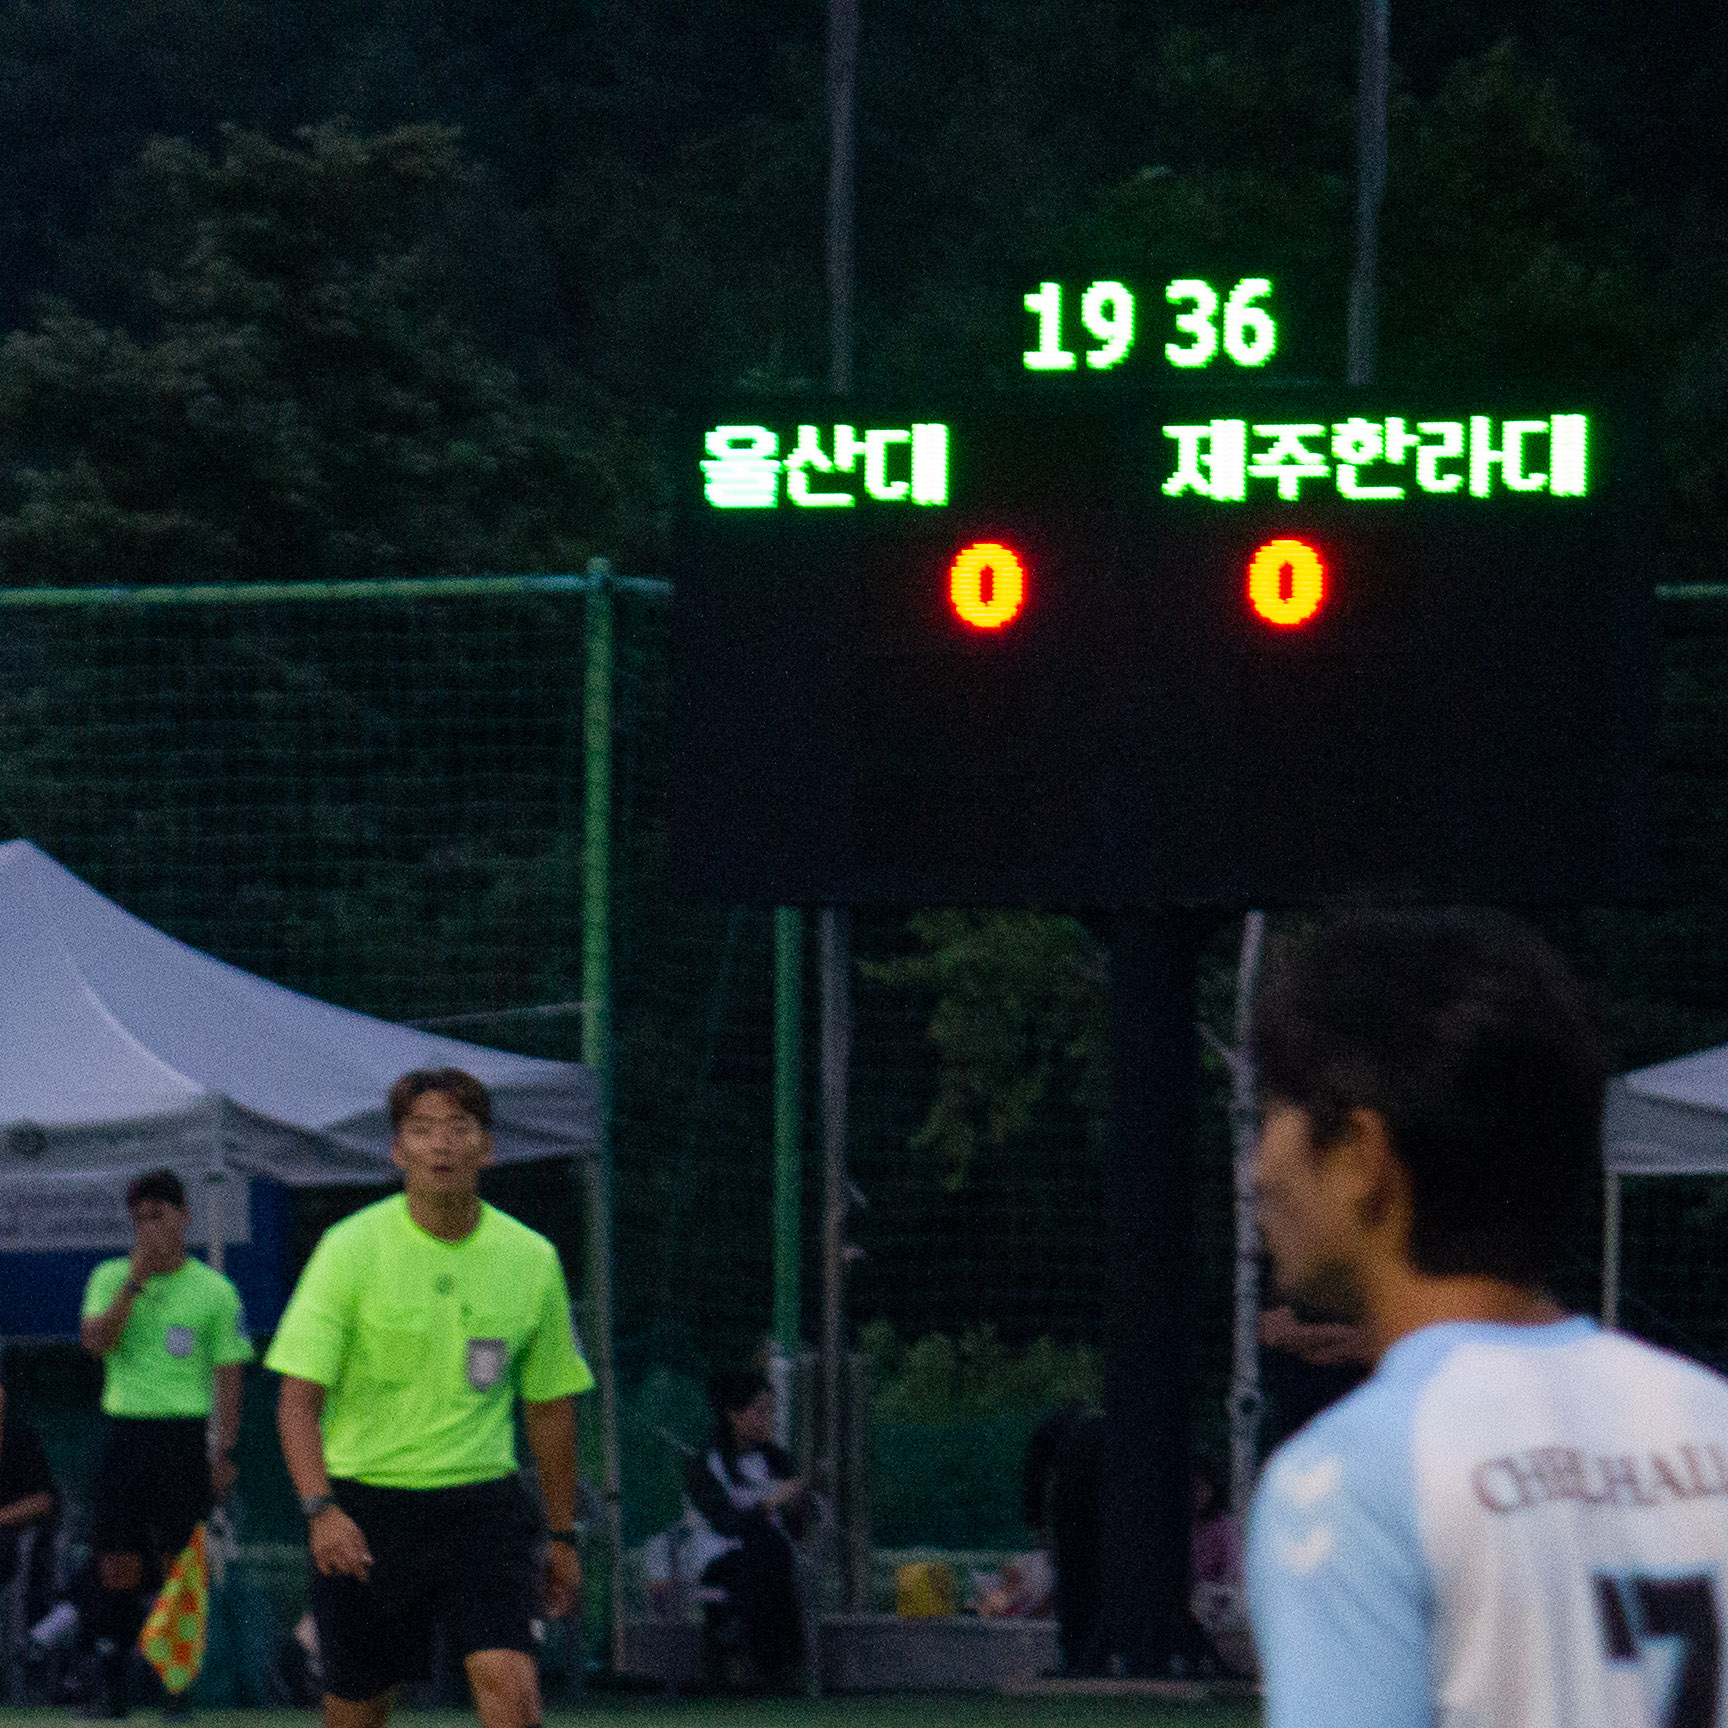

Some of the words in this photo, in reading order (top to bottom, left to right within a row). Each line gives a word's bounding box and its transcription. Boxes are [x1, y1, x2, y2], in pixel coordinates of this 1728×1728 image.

[1023, 281, 1135, 371] 19
[1165, 278, 1277, 368] 36
[700, 423, 949, 509] 울산대
[1162, 414, 1589, 502] 제주한라대
[948, 541, 1027, 630] 0
[1247, 538, 1327, 628] 0
